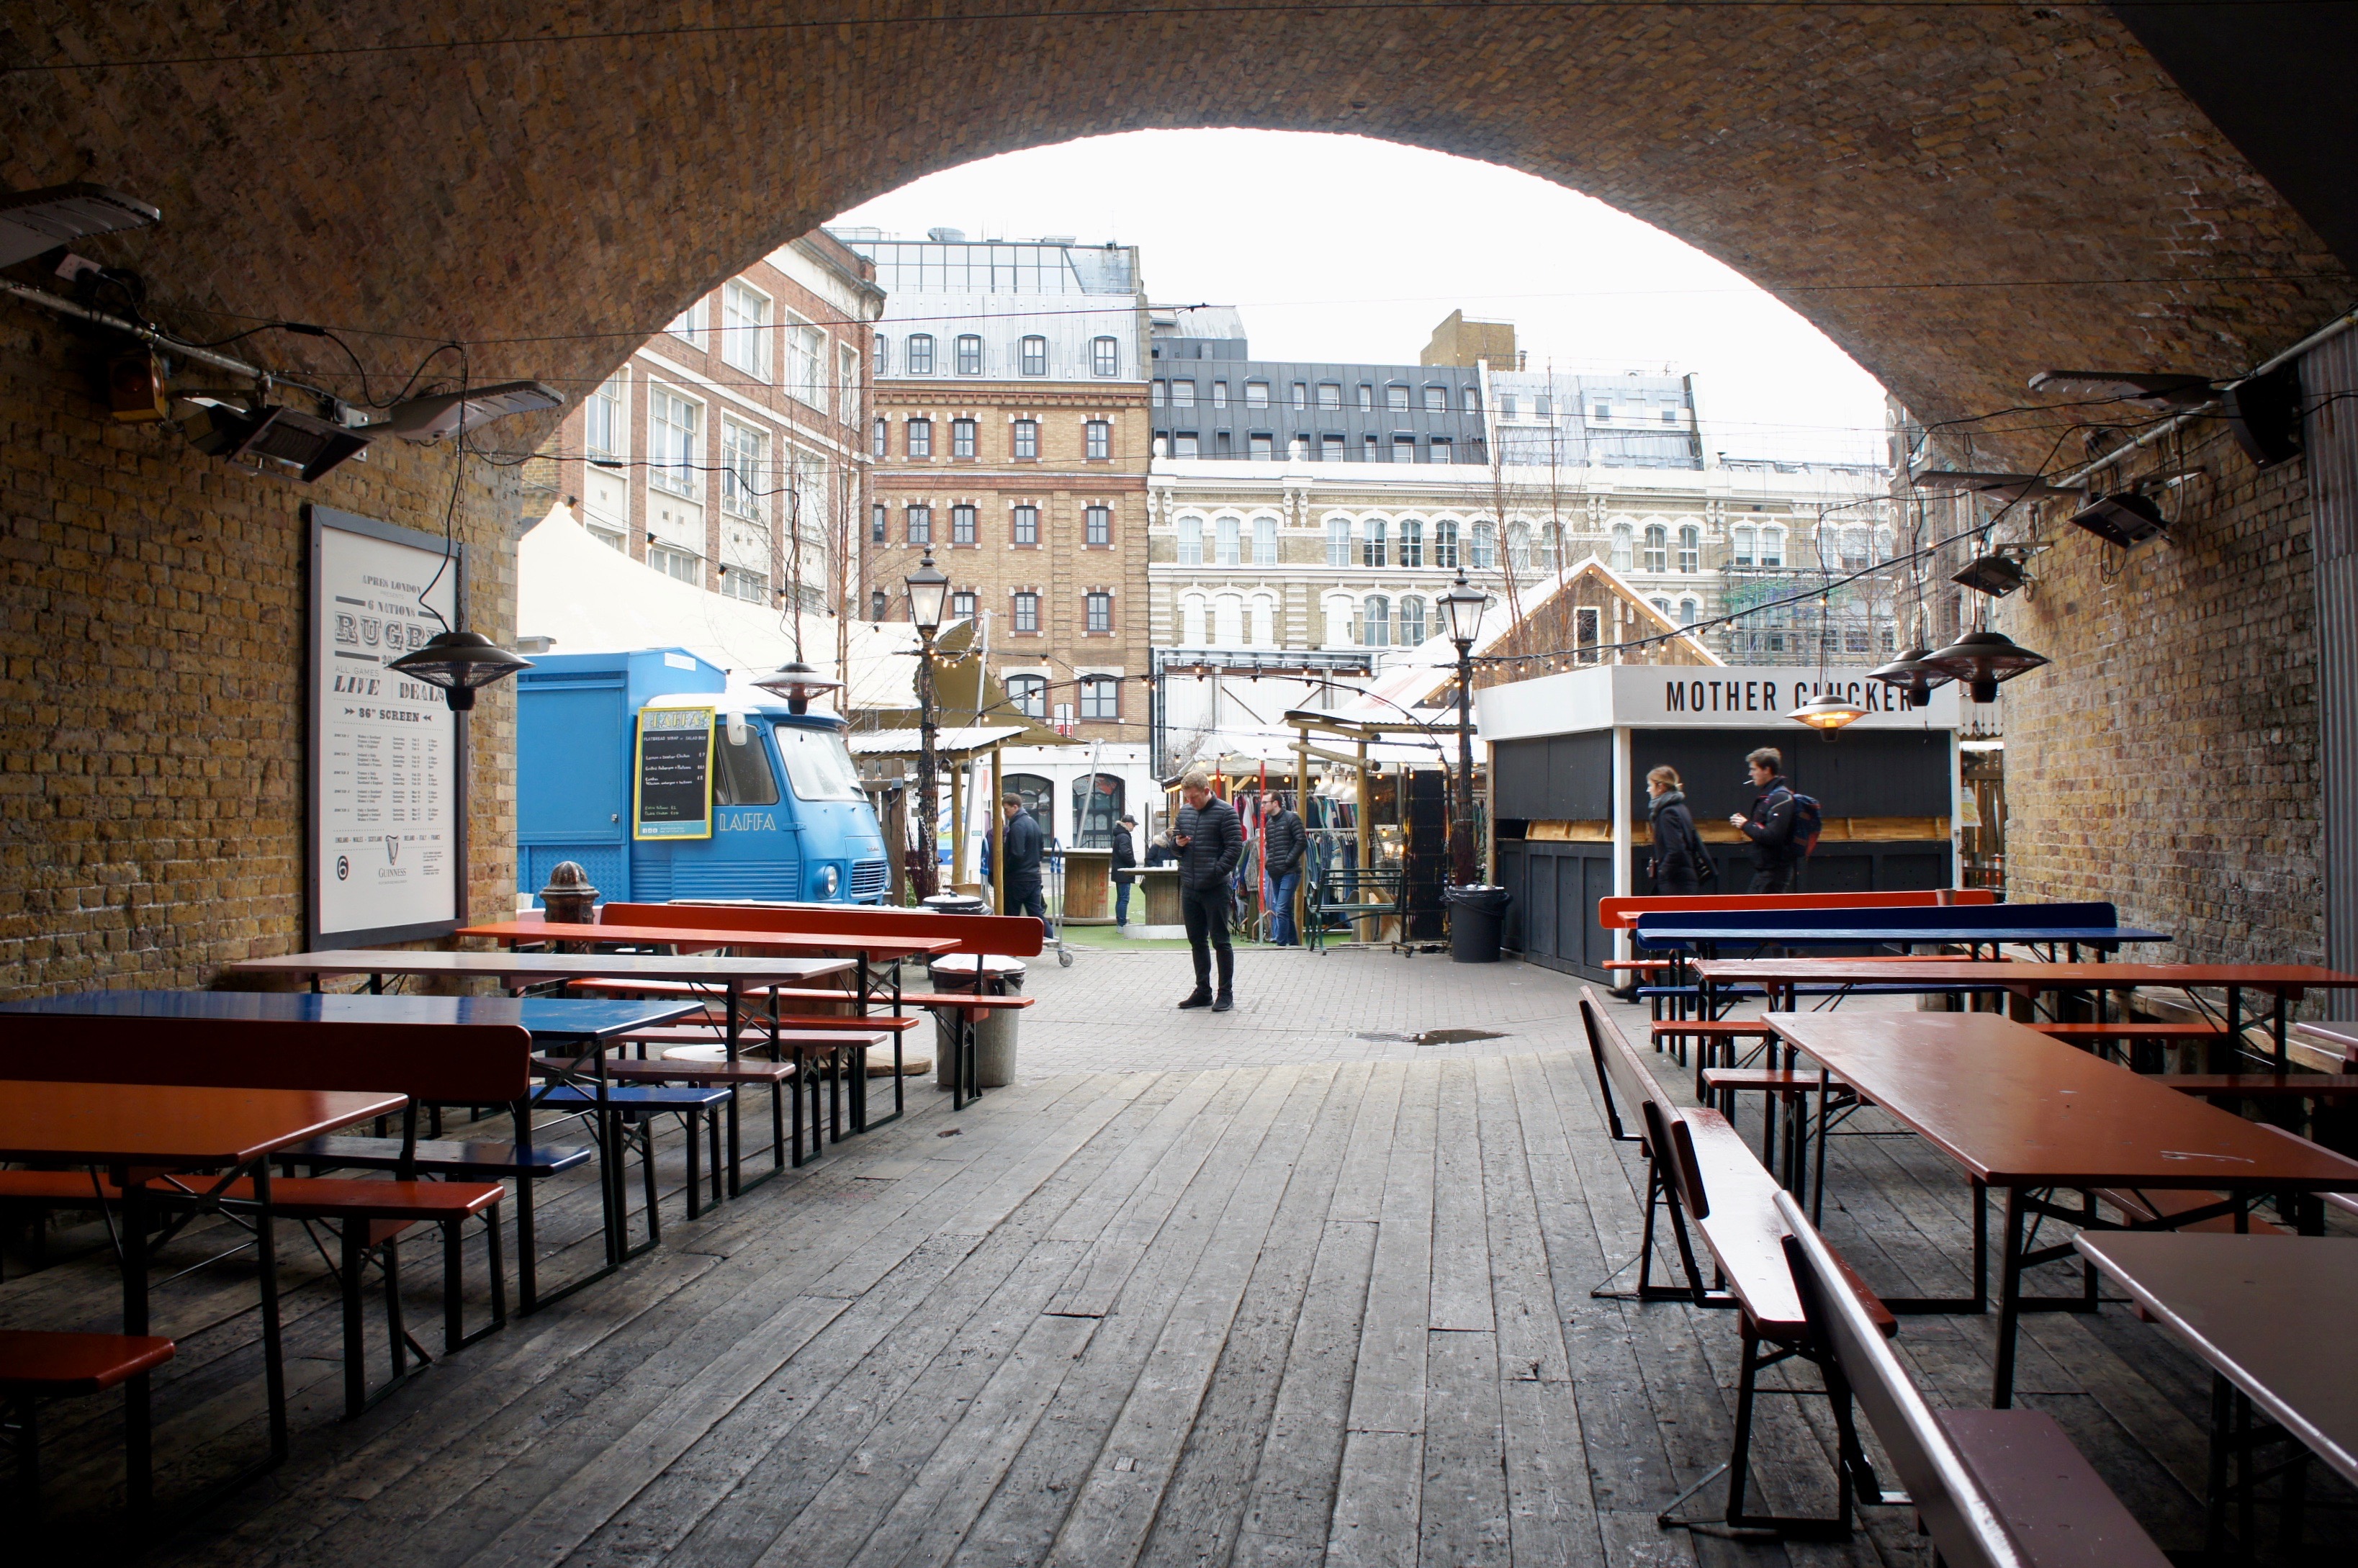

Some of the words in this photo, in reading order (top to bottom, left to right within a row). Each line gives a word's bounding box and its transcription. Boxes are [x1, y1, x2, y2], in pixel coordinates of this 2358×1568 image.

[362, 575, 389, 587] APRES
[391, 581, 422, 595] LONDON
[368, 600, 374, 610] 6
[377, 602, 415, 618] NATIONS
[335, 665, 350, 674] ALL
[354, 667, 379, 677] GAMES
[333, 675, 380, 695] LIVE
[400, 682, 445, 703] DEALS
[1665, 681, 1777, 711] MOTHER
[379, 709, 420, 723] SCREEN
[719, 813, 776, 832] LAFFA
[378, 868, 407, 878] GUINNESS
